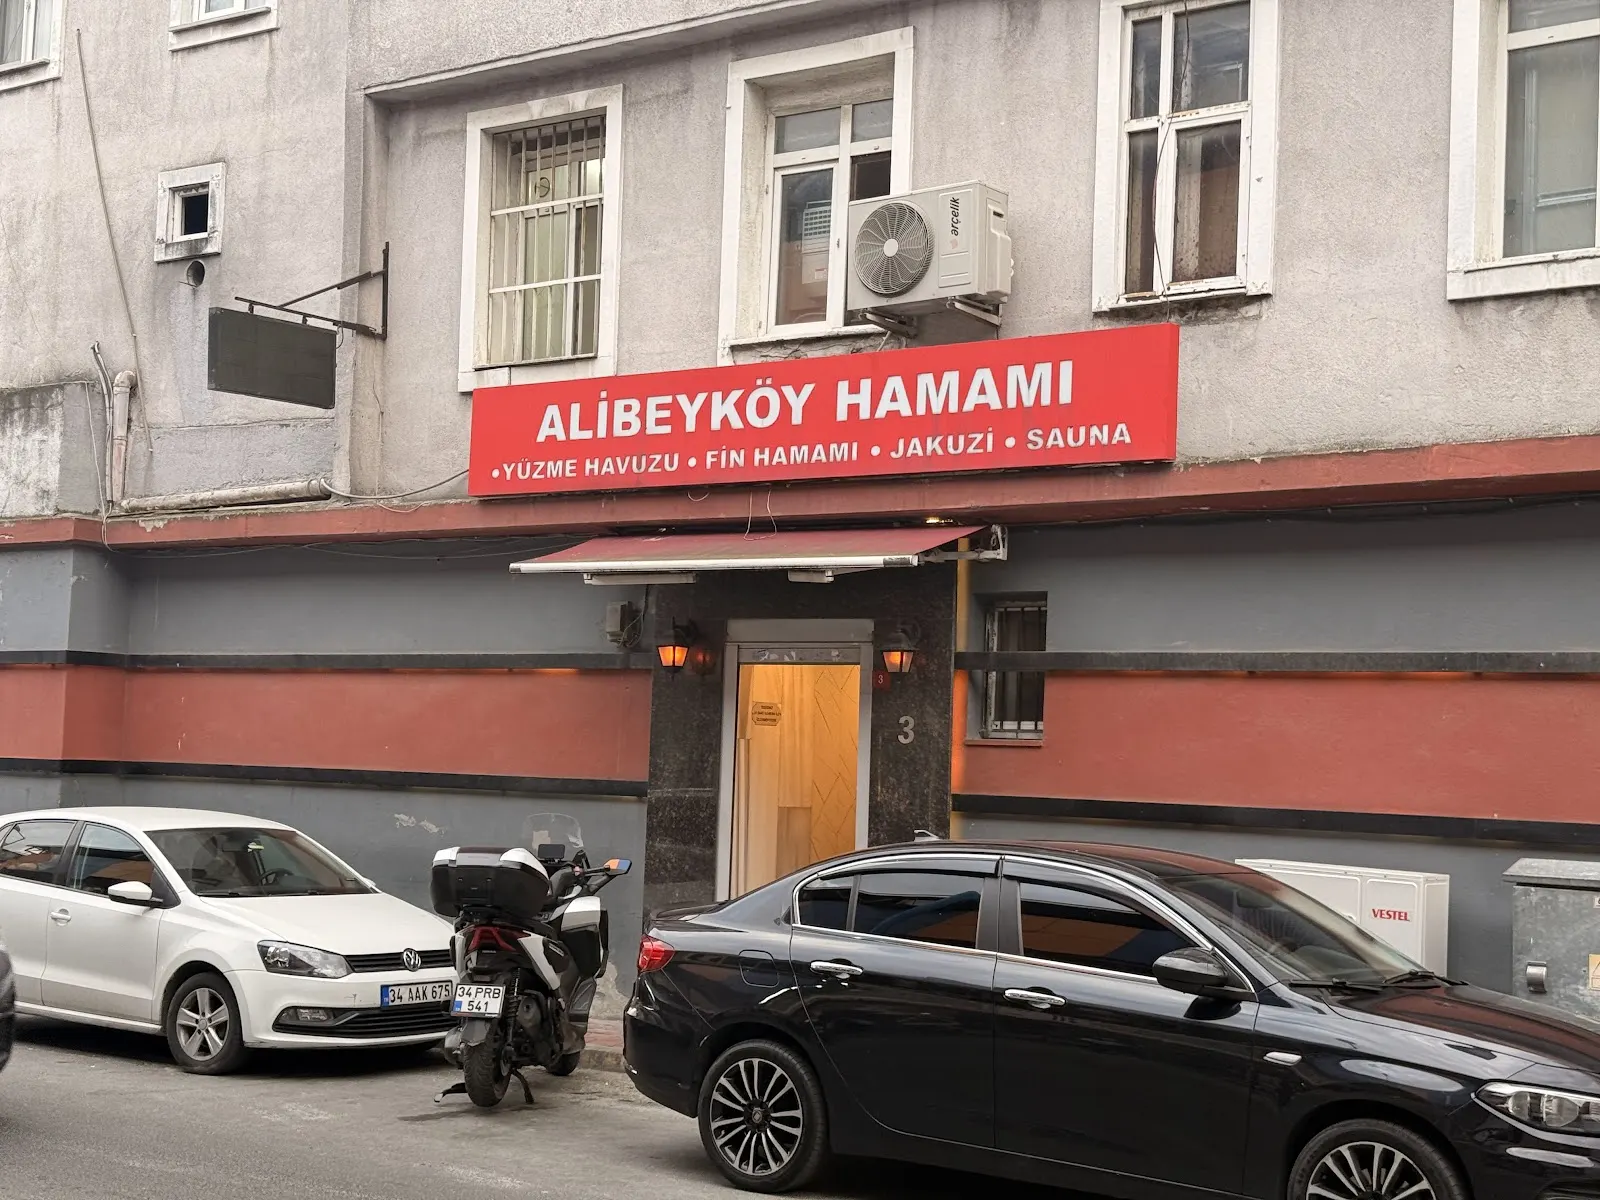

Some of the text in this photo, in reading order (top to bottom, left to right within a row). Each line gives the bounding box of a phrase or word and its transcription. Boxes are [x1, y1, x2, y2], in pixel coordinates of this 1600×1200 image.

[950, 196, 962, 237] arçelik
[536, 360, 1074, 442] ALİBEYKÖY HAMAMI
[502, 422, 1132, 481] YÜZME HAVUZU FİN HAMAMI JAKUZİ SAUNA
[877, 674, 884, 684] 3
[897, 715, 915, 744] 3
[1372, 908, 1410, 922] VESTEL
[390, 988, 403, 1003] 34
[408, 986, 428, 1002] AAK
[431, 984, 450, 999] 675
[458, 987, 501, 999] 34 PRB
[467, 1000, 489, 1012] 541
